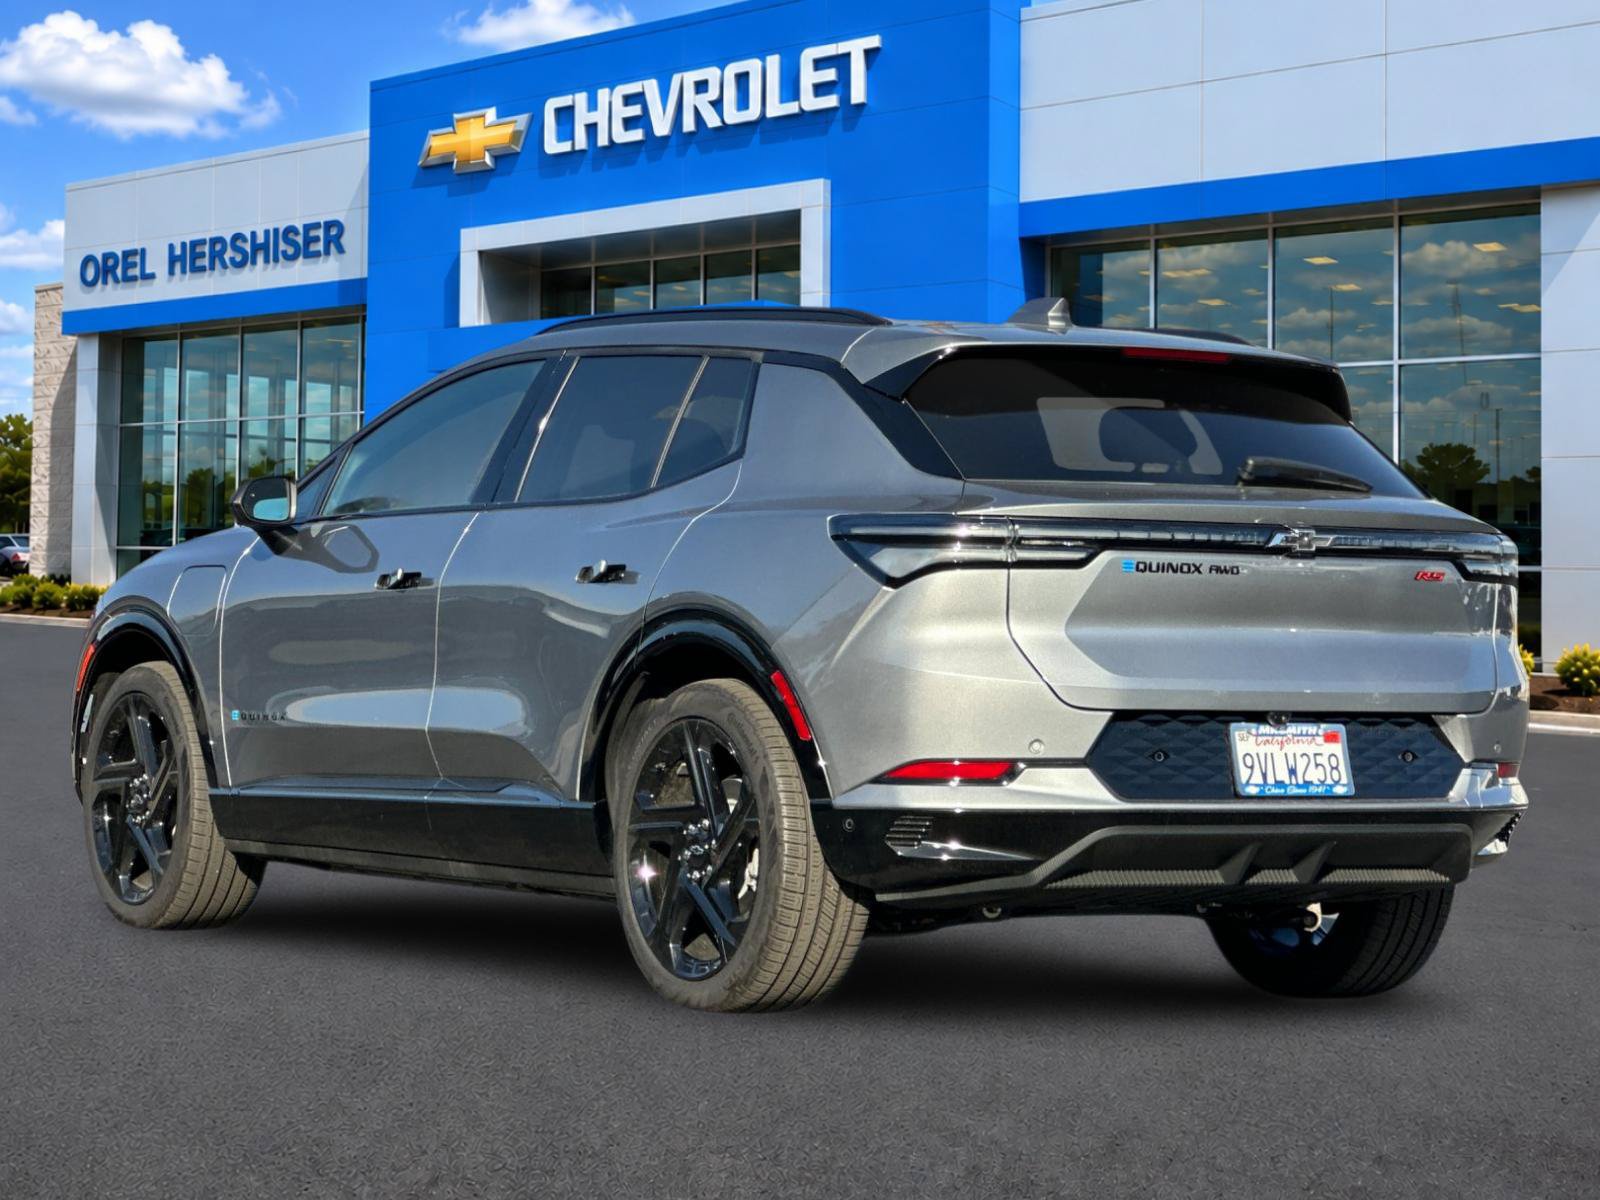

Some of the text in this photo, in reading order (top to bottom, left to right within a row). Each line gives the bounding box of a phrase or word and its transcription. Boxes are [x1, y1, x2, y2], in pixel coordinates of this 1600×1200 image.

[544, 34, 882, 155] CHEVROLET
[79, 219, 345, 288] OREL HERSHISER
[1122, 559, 1241, 576] EQUINOX AWD
[1414, 570, 1446, 582] RS
[1242, 752, 1342, 785] 9VLW258
